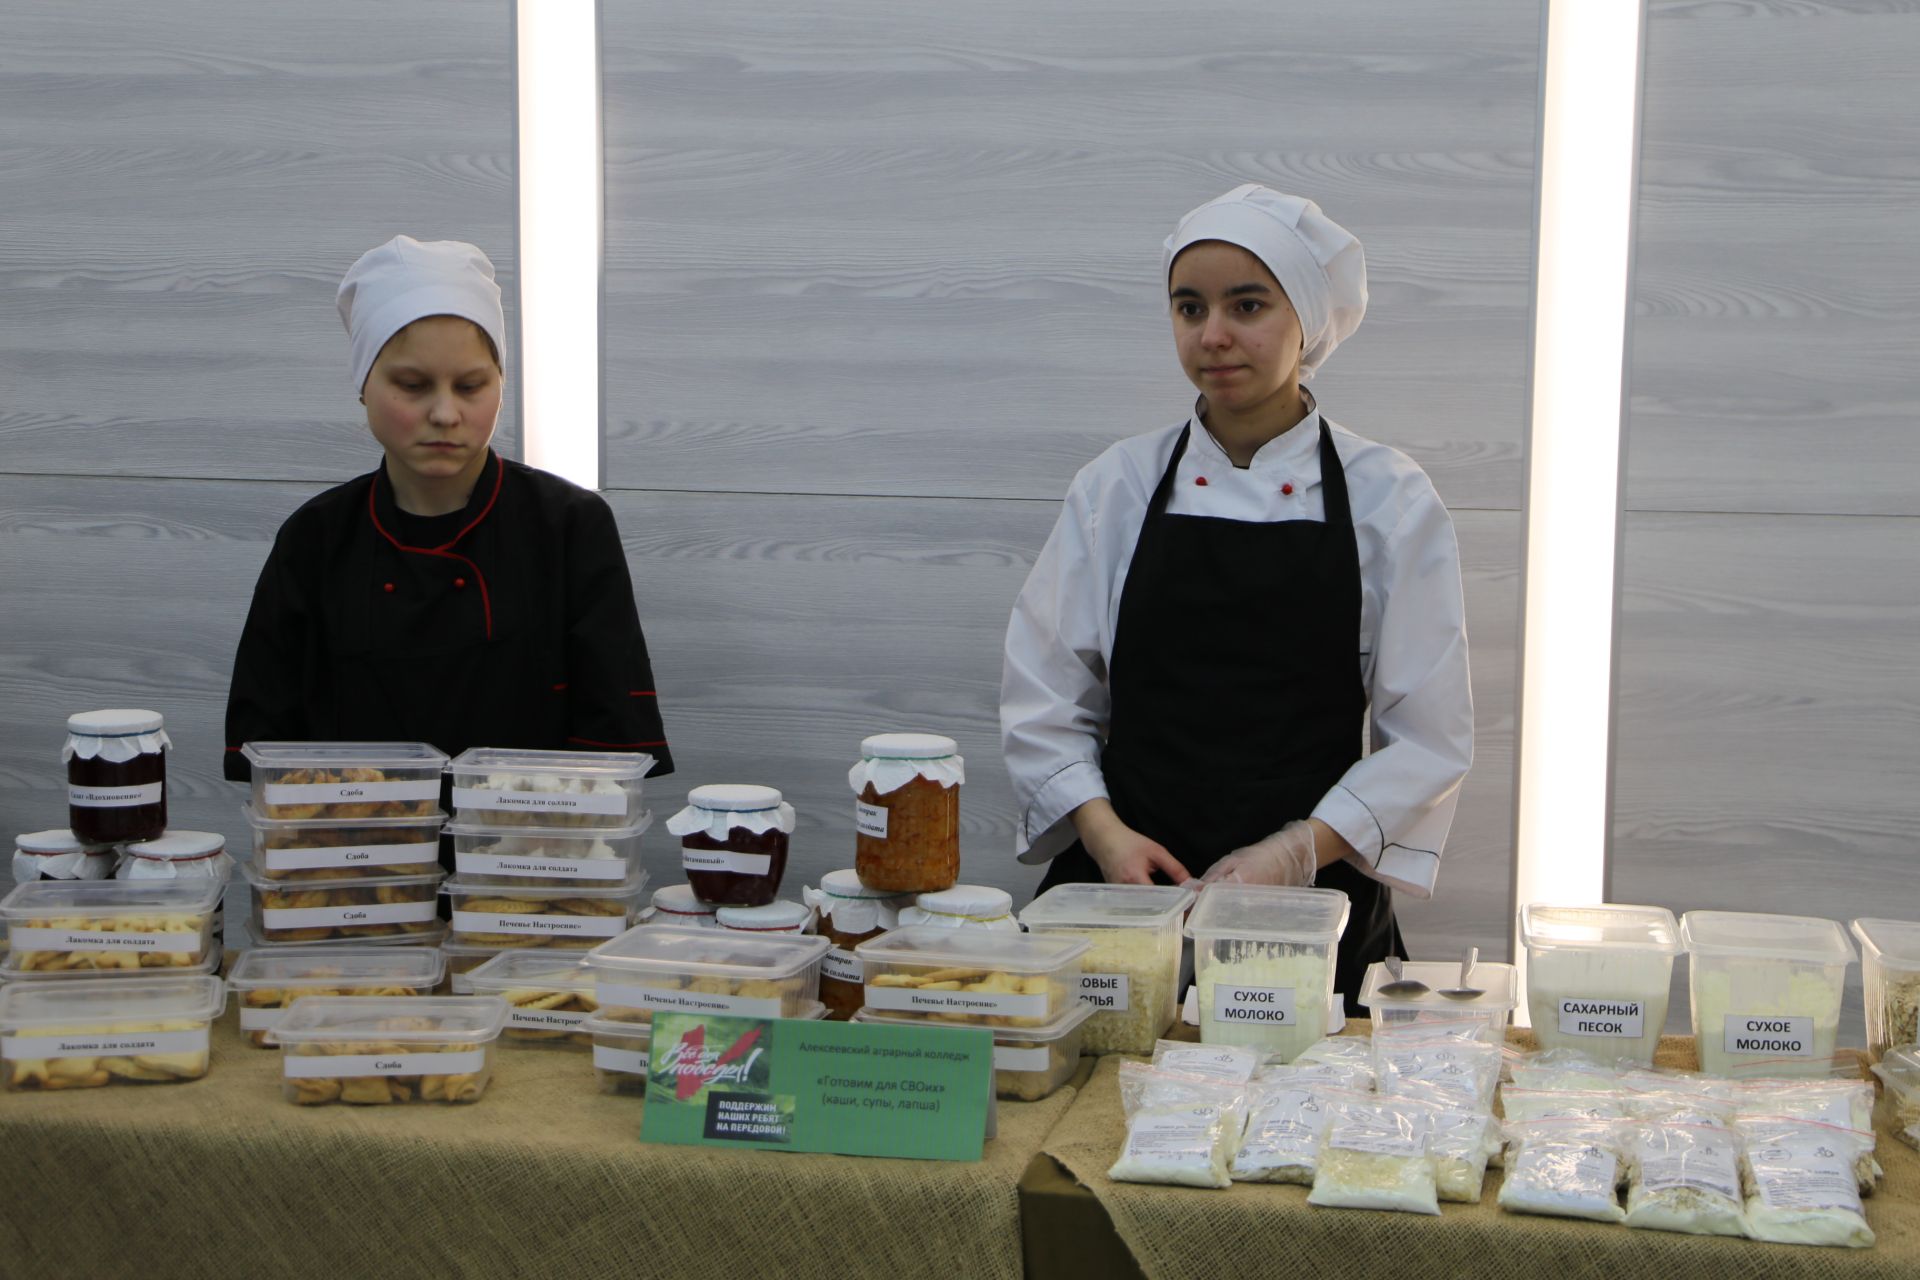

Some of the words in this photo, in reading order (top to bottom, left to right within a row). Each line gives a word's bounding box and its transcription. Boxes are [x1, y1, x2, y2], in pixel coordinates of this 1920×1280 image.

[340, 789, 364, 797] Сдоба
[496, 797, 530, 805] Лакомка
[532, 799, 546, 807] для
[547, 799, 577, 807] солдата
[345, 852, 369, 861] Сдоба
[497, 862, 531, 871] Лакомка
[533, 864, 547, 872] для
[548, 865, 578, 873] солдата
[343, 912, 367, 920] Сдоба
[499, 920, 531, 929] Печенье
[65, 936, 104, 945] Лакомка
[106, 937, 121, 946] для
[123, 938, 156, 946] солдата
[1080, 977, 1118, 989] ОВЫЕ
[643, 994, 677, 1004] Печенье
[911, 996, 944, 1006] Печенье
[946, 997, 998, 1009] Настроение»
[1233, 990, 1275, 1003] СУХОЕ
[1225, 1007, 1285, 1021] МОЛОКО
[1563, 1001, 1639, 1017] САХАРНЫЙ
[512, 1013, 545, 1024] Печенье
[1578, 1021, 1623, 1034] ПЕСОК
[1746, 1020, 1791, 1033] СУХОЕ
[58, 1042, 99, 1051] Лакомка
[101, 1041, 118, 1050] для
[119, 1041, 155, 1049] солдата
[1736, 1038, 1802, 1052] МОЛОКО
[799, 1042, 870, 1055] Алексеевский
[872, 1047, 922, 1059] аграрный
[924, 1050, 970, 1062] колледж
[375, 1061, 402, 1070] Сдоба
[817, 1076, 873, 1089] «Готовим
[875, 1079, 897, 1091] для
[901, 1080, 945, 1093] СВОих»
[719, 1100, 777, 1113] ПОДДЕРЖИМ
[822, 1093, 860, 1108] (каши,
[863, 1097, 895, 1110] супы,
[897, 1099, 941, 1112] лапша)
[718, 1111, 750, 1121] НАШИХ
[752, 1113, 780, 1123] РЕБЯТ
[716, 1122, 729, 1131] НА
[730, 1123, 786, 1135] ПЕРЕДОВОЙ!
